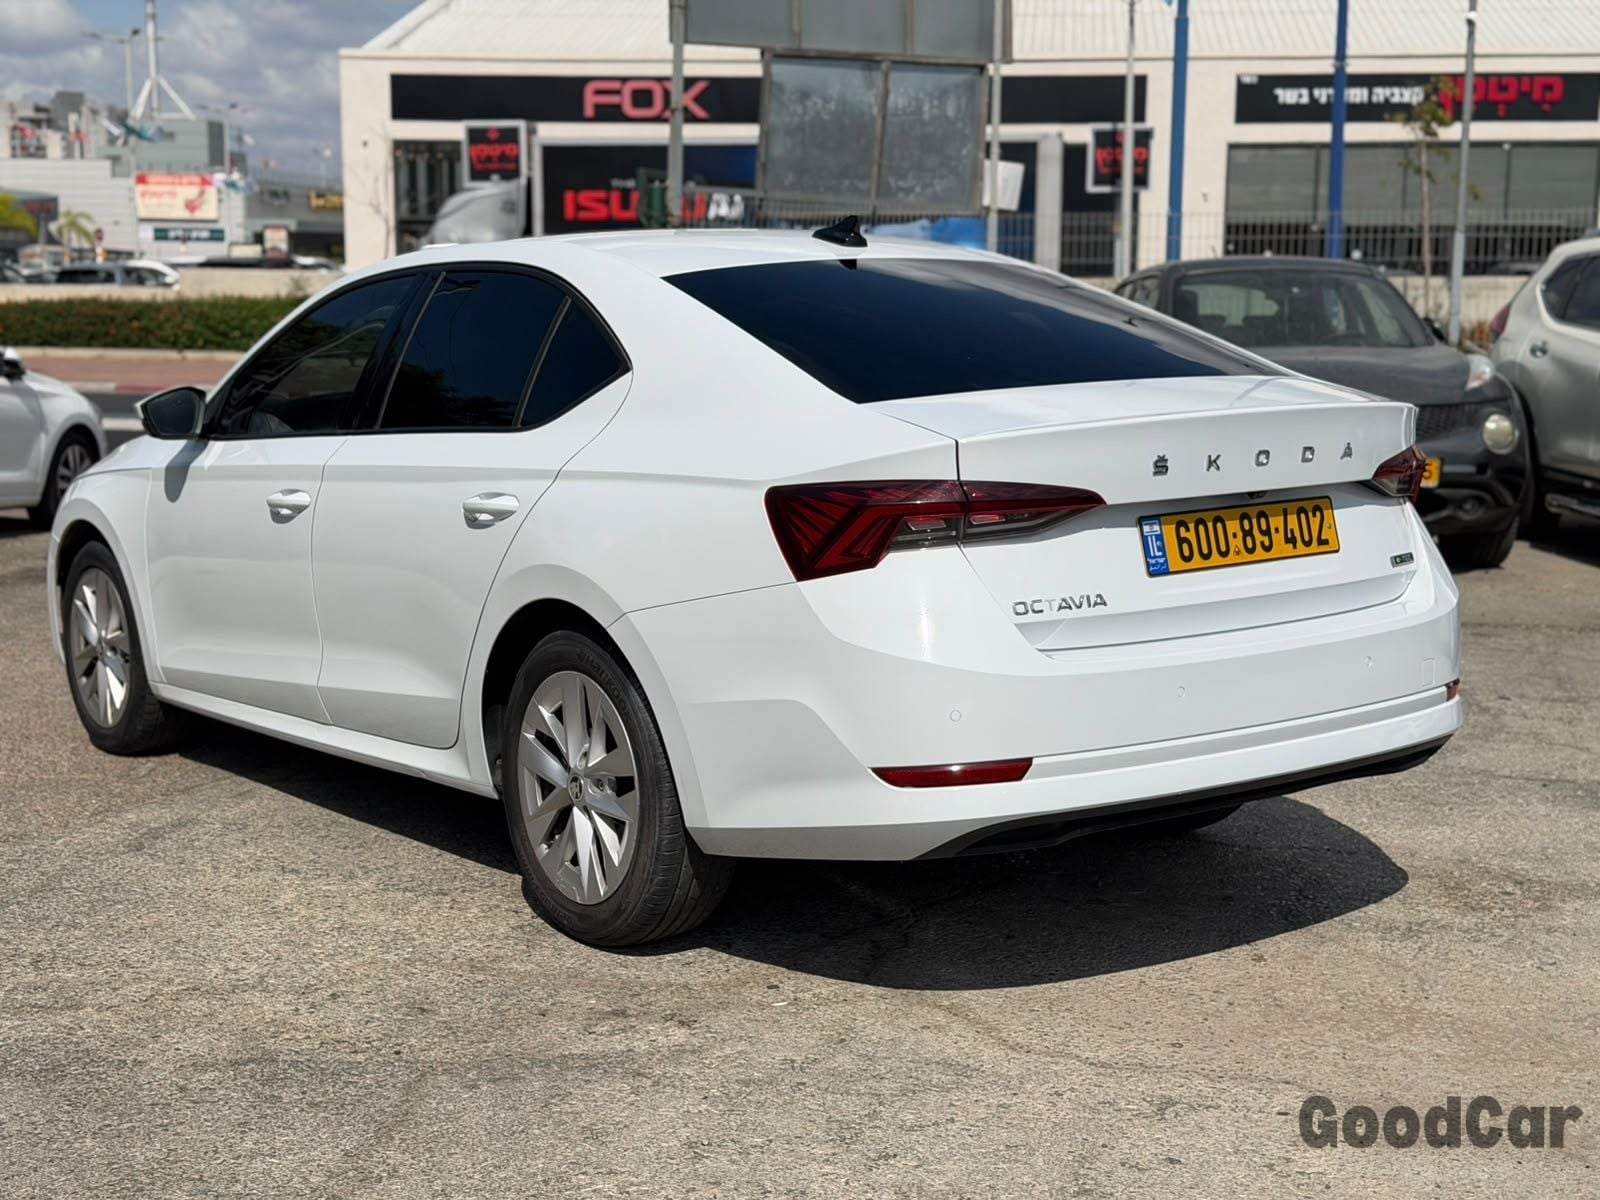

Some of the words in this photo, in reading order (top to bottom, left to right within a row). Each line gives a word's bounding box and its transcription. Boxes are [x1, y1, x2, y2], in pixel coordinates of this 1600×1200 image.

[583, 80, 710, 119] FOX
[564, 189, 707, 222] ISUU
[1147, 535, 1163, 557] IL
[1011, 593, 1108, 616] OCTAVIA
